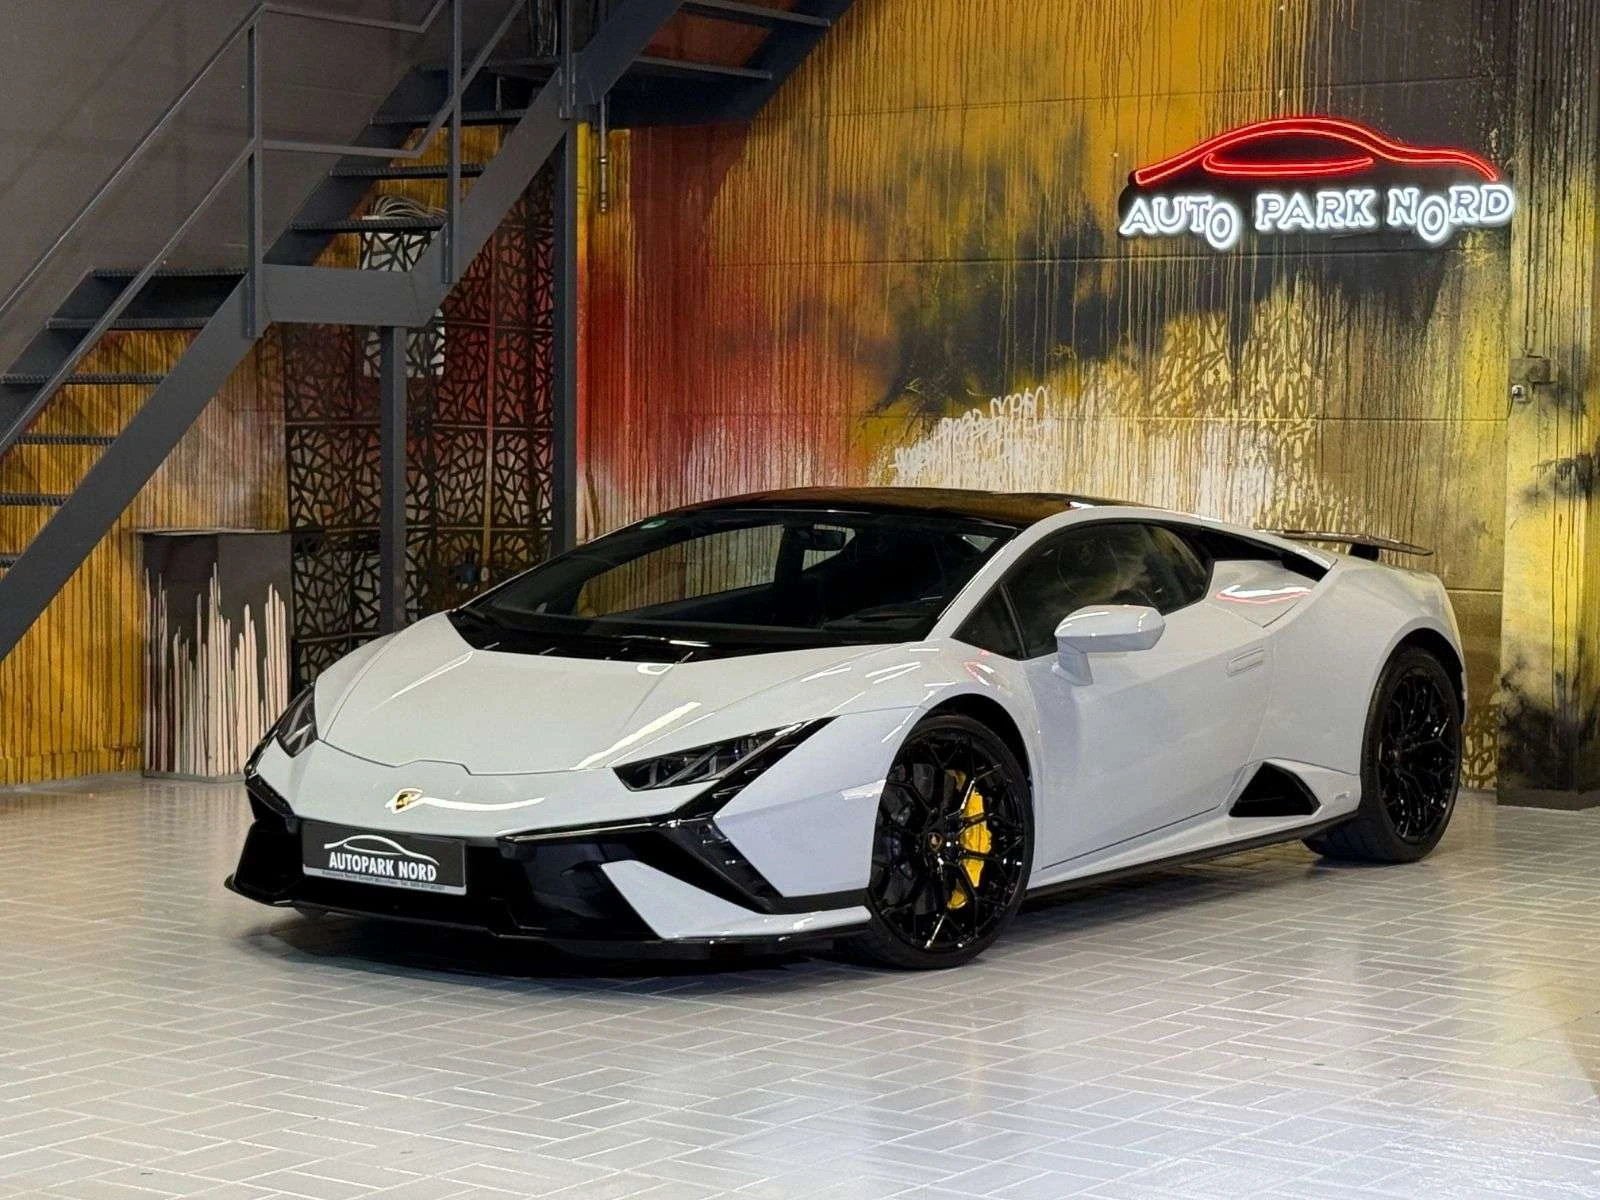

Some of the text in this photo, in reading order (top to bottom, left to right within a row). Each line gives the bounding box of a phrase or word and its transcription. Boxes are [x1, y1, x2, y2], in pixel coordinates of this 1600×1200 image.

[1119, 184, 1516, 249] AUTO PARK NORD
[328, 851, 395, 877] AUTOPARK
[398, 861, 438, 882] NORD
